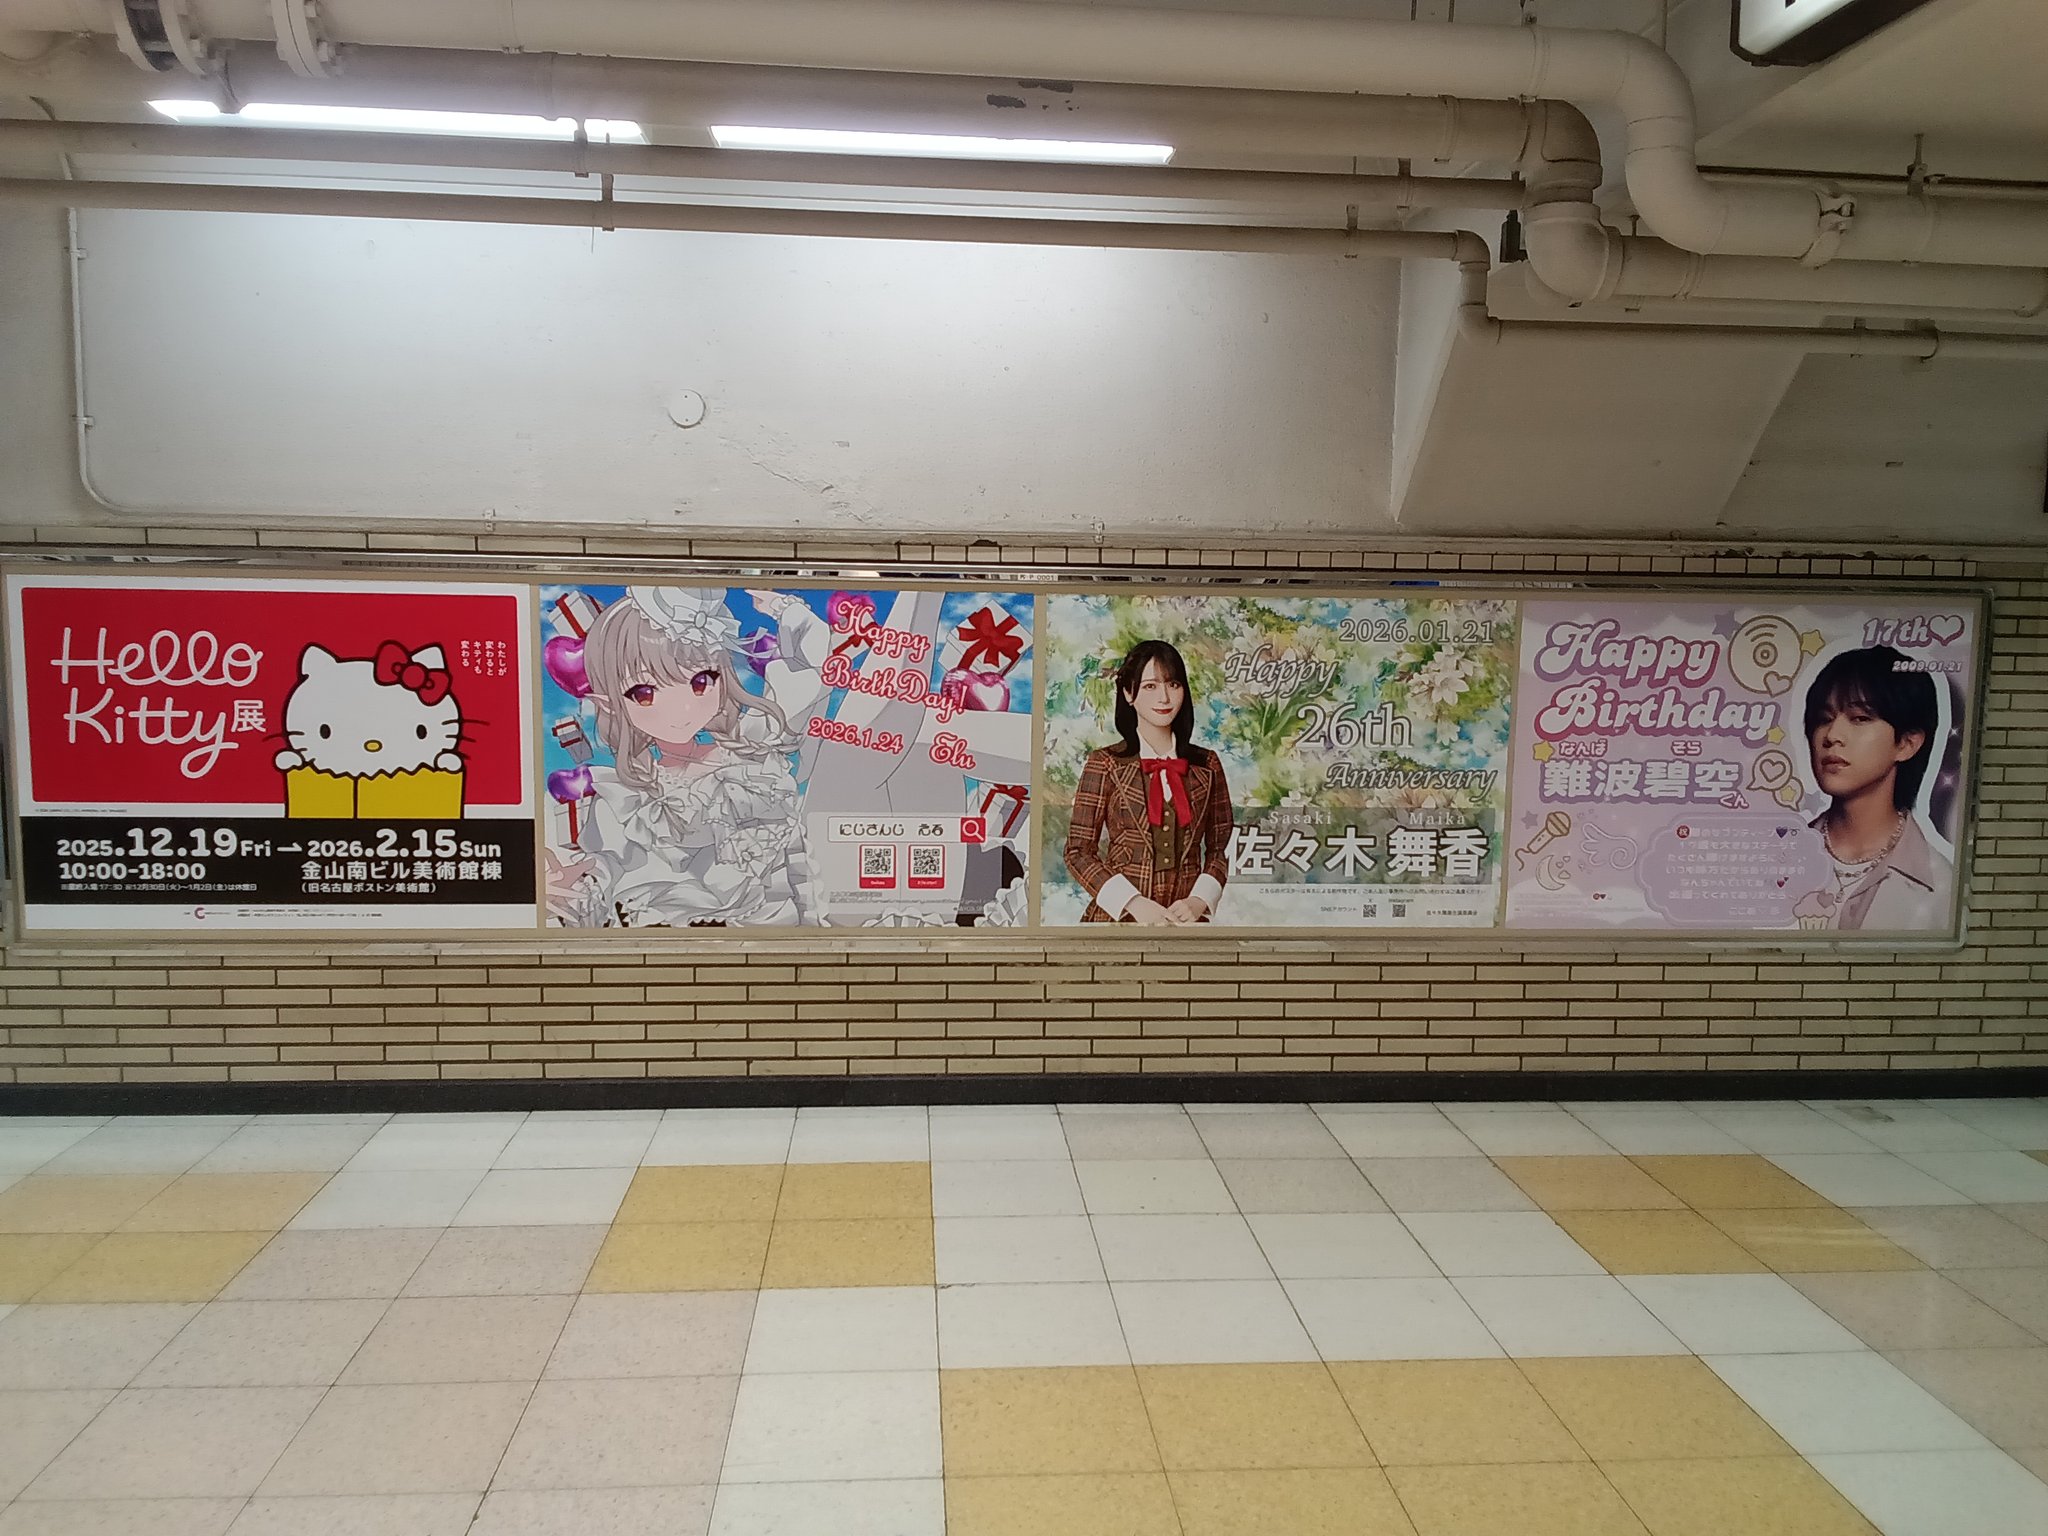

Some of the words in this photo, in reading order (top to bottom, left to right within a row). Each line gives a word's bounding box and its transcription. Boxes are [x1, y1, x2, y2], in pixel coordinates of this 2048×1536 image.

[829, 599, 931, 663] Happy
[1339, 619, 1494, 643] 2026.01.21
[1862, 616, 1932, 648] 17th
[50, 626, 264, 687] Hello
[472, 640, 482, 674] キティも
[497, 640, 507, 676] わたしが
[1224, 643, 1340, 698] Happy
[1534, 618, 1720, 688] Happy
[1296, 701, 1414, 749] 26th
[1534, 676, 1781, 748] Birthday
[63, 687, 239, 779] Kitty
[231, 699, 267, 733] 展
[808, 717, 904, 754] 2026.1.24
[930, 732, 976, 769] Elu
[1559, 740, 1608, 757] なんば
[1671, 741, 1702, 756] そら
[1324, 762, 1498, 801] Anniversary
[1540, 758, 1743, 804] 難波碧空
[839, 823, 904, 837] にじさんじ
[918, 823, 944, 837] える
[1269, 811, 1332, 825] Sasaki
[1408, 811, 1465, 825] Maika
[56, 827, 238, 857] 2025.12.19
[239, 840, 272, 857] Fri
[307, 828, 457, 858] 2026.2.15
[459, 841, 502, 857] Sun
[1224, 826, 1377, 878] 佐々木
[1386, 826, 1490, 878] 舞香
[301, 860, 503, 880] 金山南ビル美術館棟
